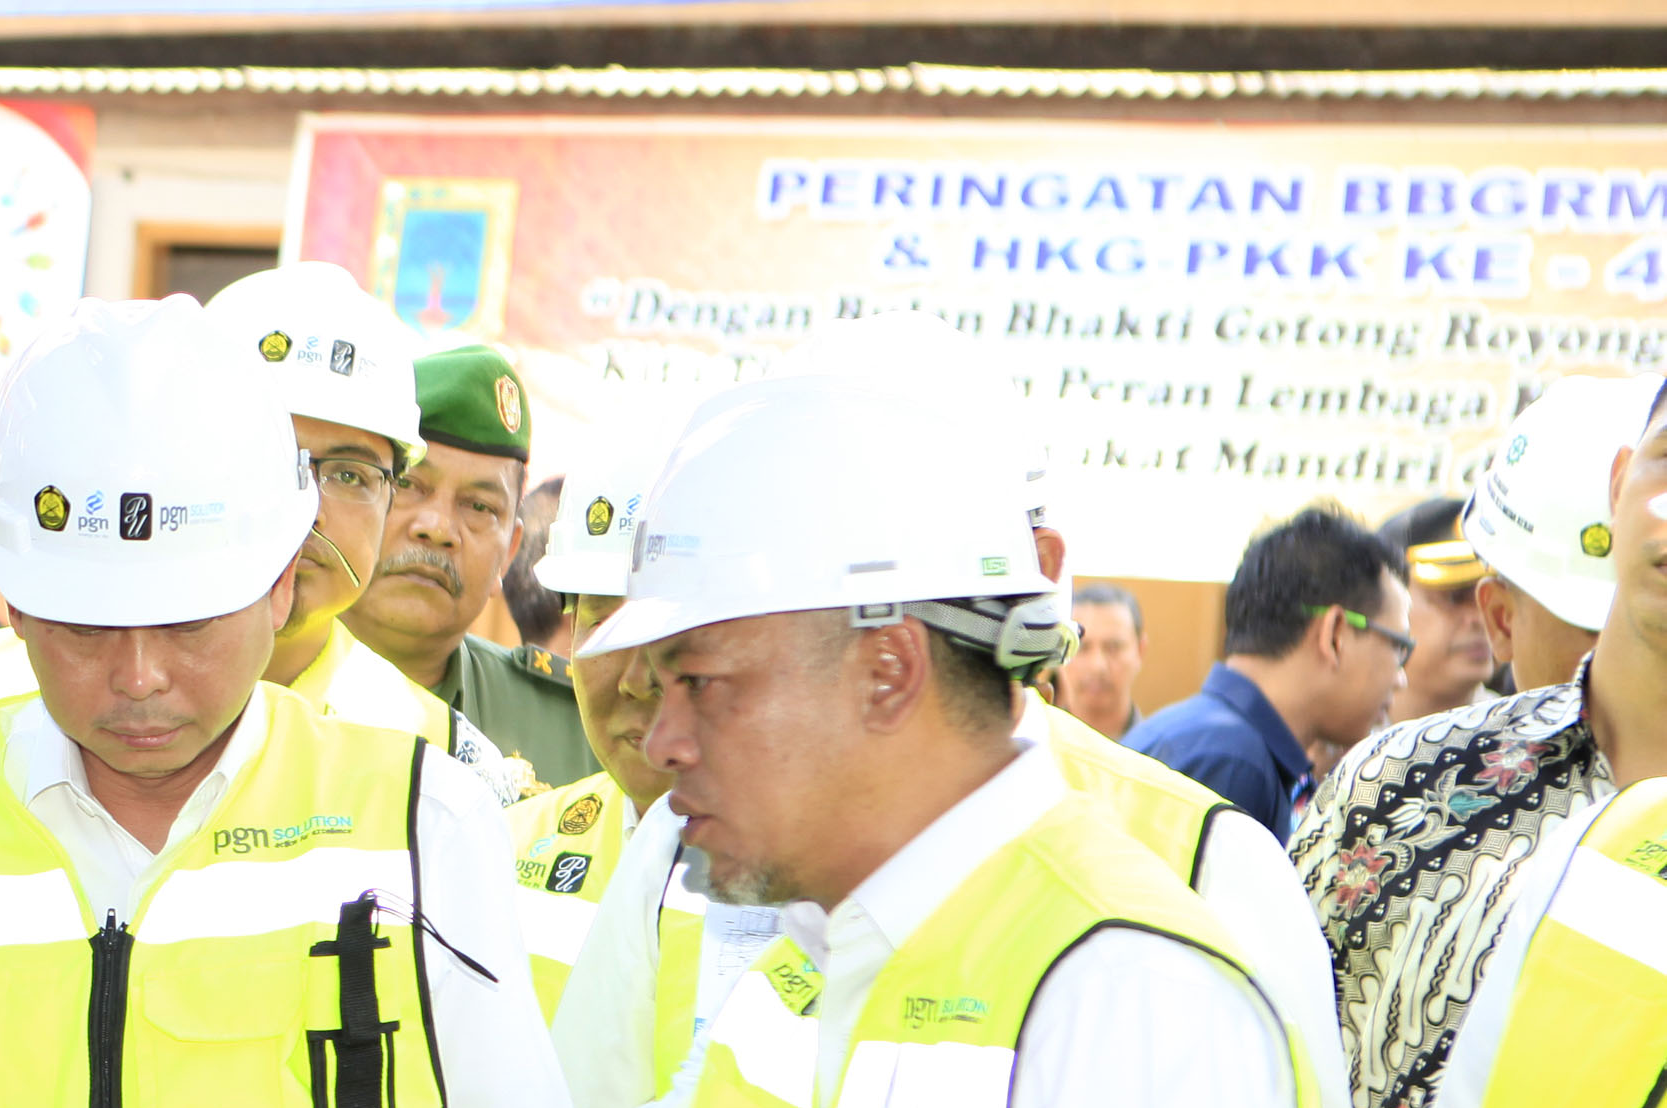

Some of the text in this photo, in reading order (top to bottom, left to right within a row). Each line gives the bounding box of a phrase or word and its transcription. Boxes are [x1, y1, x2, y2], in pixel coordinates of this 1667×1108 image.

[765, 169, 1667, 219] PERINGATAN BBGRM
[882, 233, 932, 270] &
[1403, 243, 1524, 287] KE
[1003, 298, 1195, 343] Bhakti
[1213, 304, 1423, 361] Gotong
[1441, 311, 1667, 367] Royong
[1057, 365, 1214, 410] Peran
[1235, 371, 1491, 428] Lembaga
[1212, 436, 1443, 487] Mandiri
[78, 515, 109, 533] pgn
[159, 505, 189, 532] pgn
[618, 517, 636, 531] pg
[214, 815, 353, 855] pgn SOLUTION
